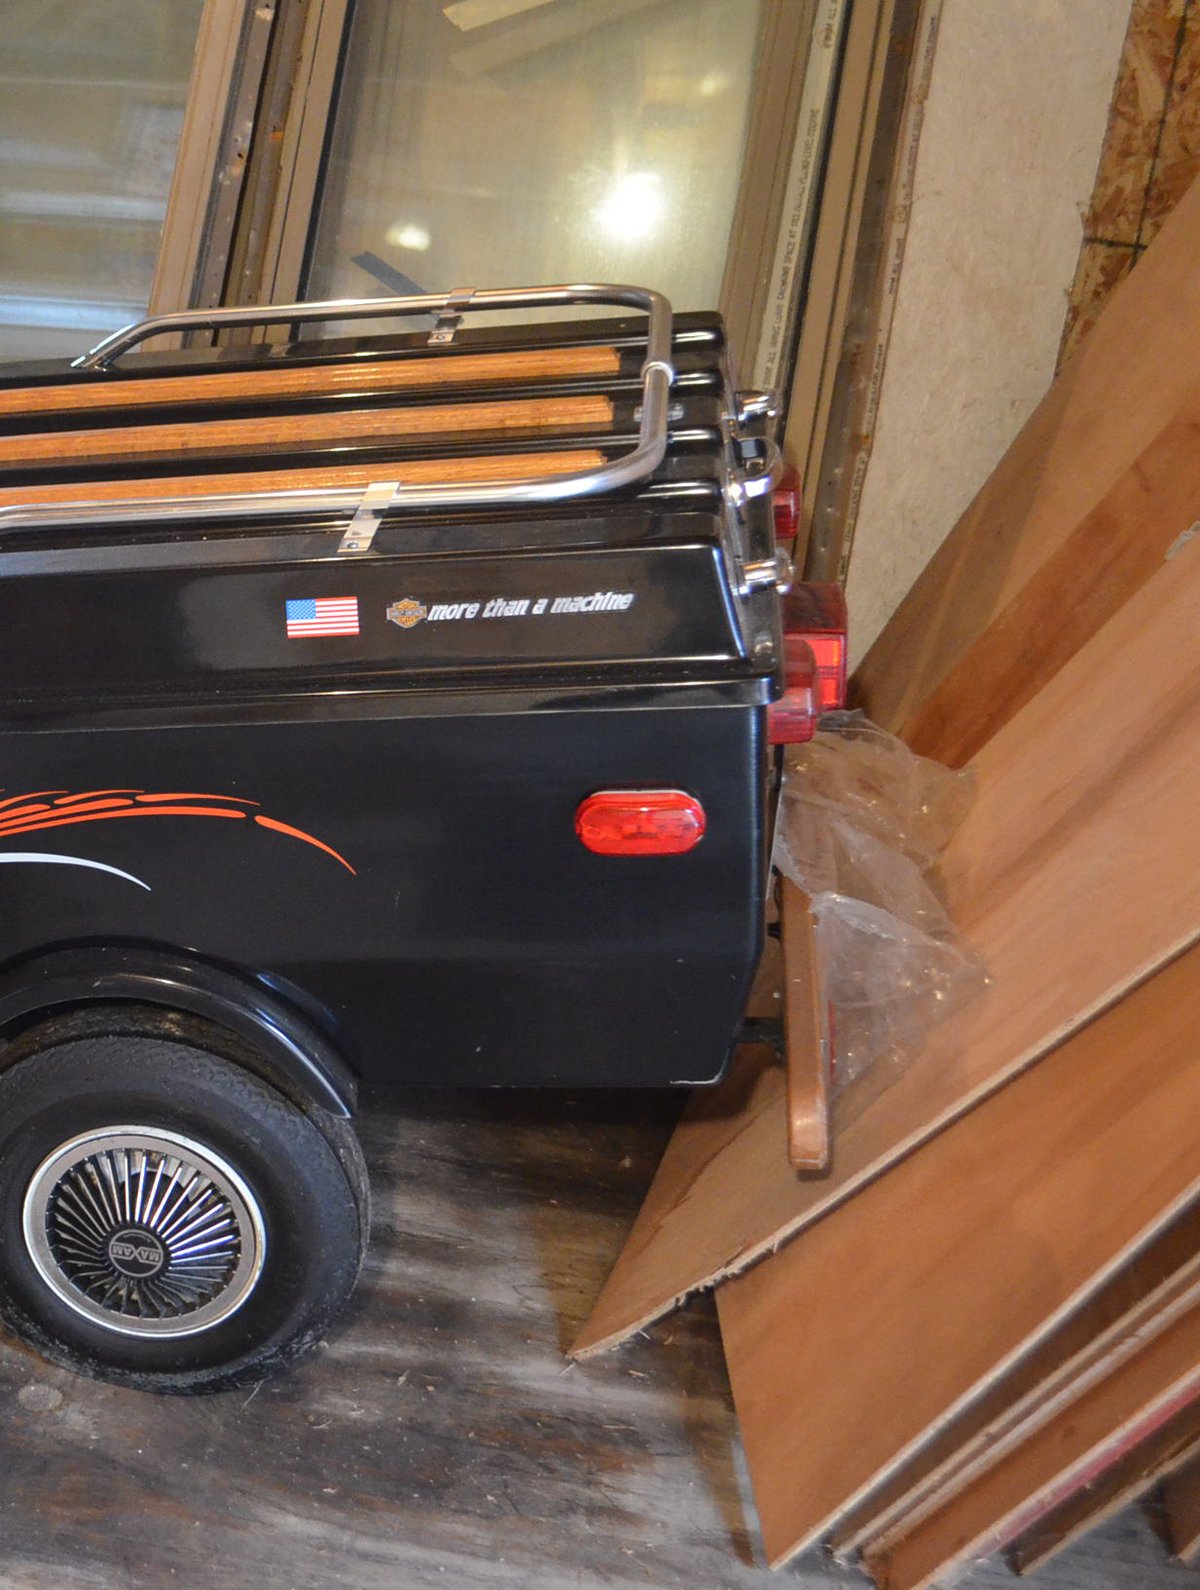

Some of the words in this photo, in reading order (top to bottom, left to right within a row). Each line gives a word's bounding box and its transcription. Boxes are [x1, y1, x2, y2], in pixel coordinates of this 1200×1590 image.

[427, 602, 480, 621] more
[482, 598, 531, 618] than
[532, 598, 548, 615] a
[550, 591, 634, 613] machine
[111, 1243, 161, 1264] MAXAM
